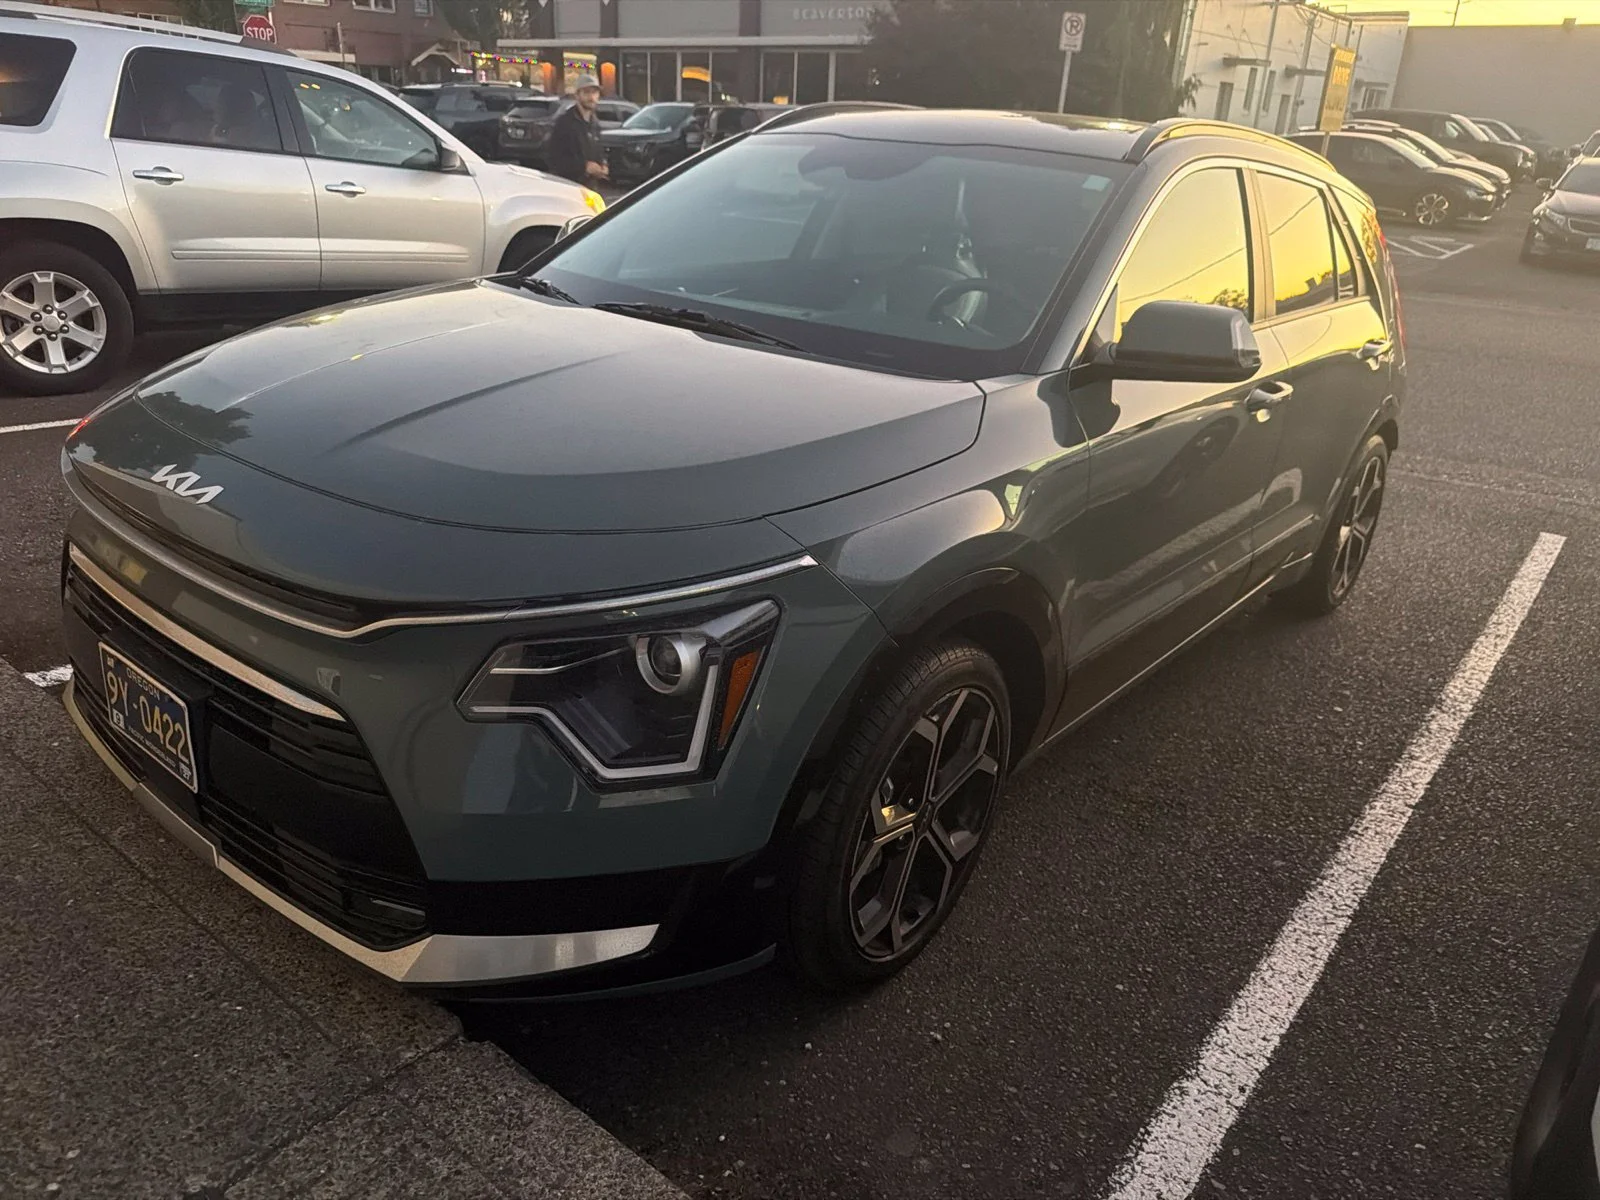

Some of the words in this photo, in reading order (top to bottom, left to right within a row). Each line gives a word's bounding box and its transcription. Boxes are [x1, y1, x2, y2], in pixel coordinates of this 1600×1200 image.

[246, 26, 273, 40] STOP
[151, 464, 224, 504] KIA
[126, 667, 160, 700] OREGON
